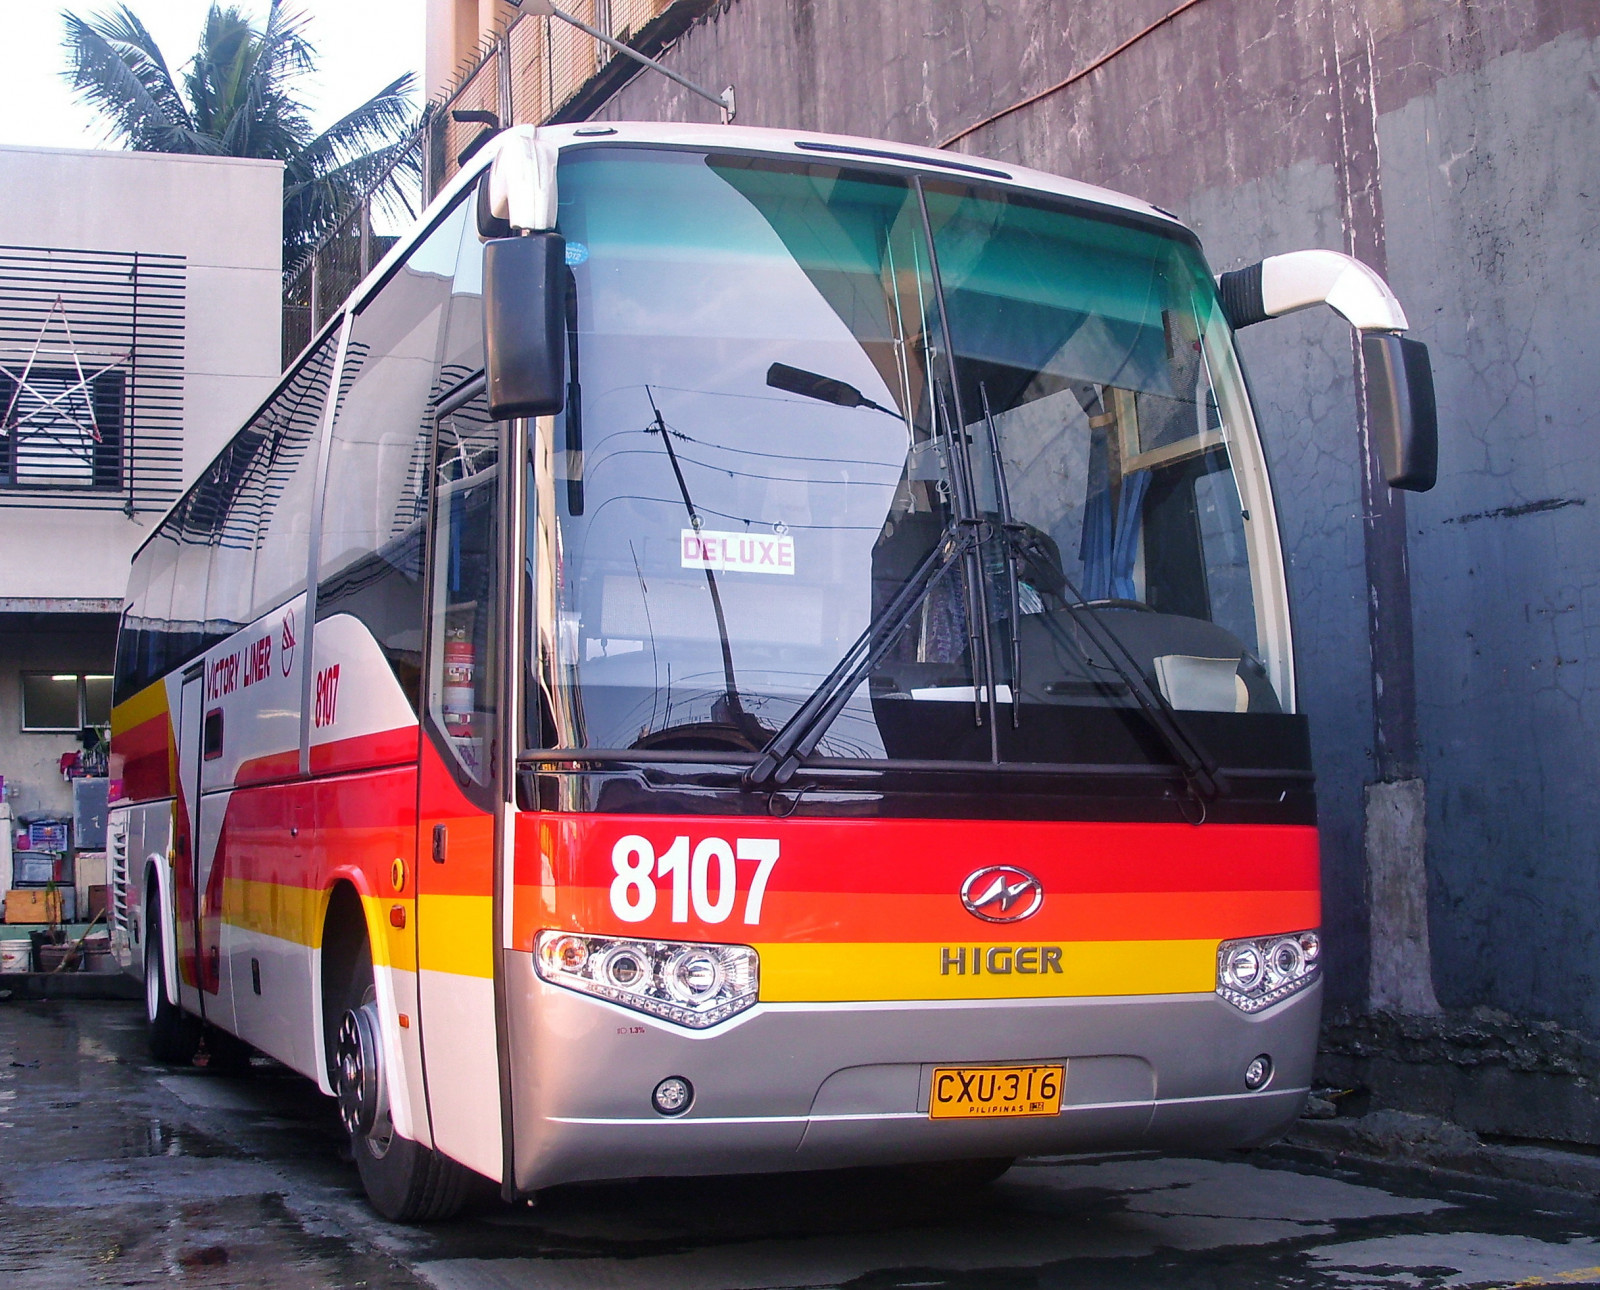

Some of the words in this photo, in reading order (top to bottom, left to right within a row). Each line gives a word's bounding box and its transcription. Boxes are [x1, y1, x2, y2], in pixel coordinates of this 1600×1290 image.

[683, 536, 792, 567] DELUXE
[206, 651, 241, 702] VICTORY
[243, 634, 272, 688] LINER
[315, 663, 340, 729] 8107
[609, 834, 781, 925] 8107
[940, 946, 1064, 976] HIGER
[629, 1026, 645, 1034] 1.3%
[969, 1105, 1024, 1114] PILIPINAS
